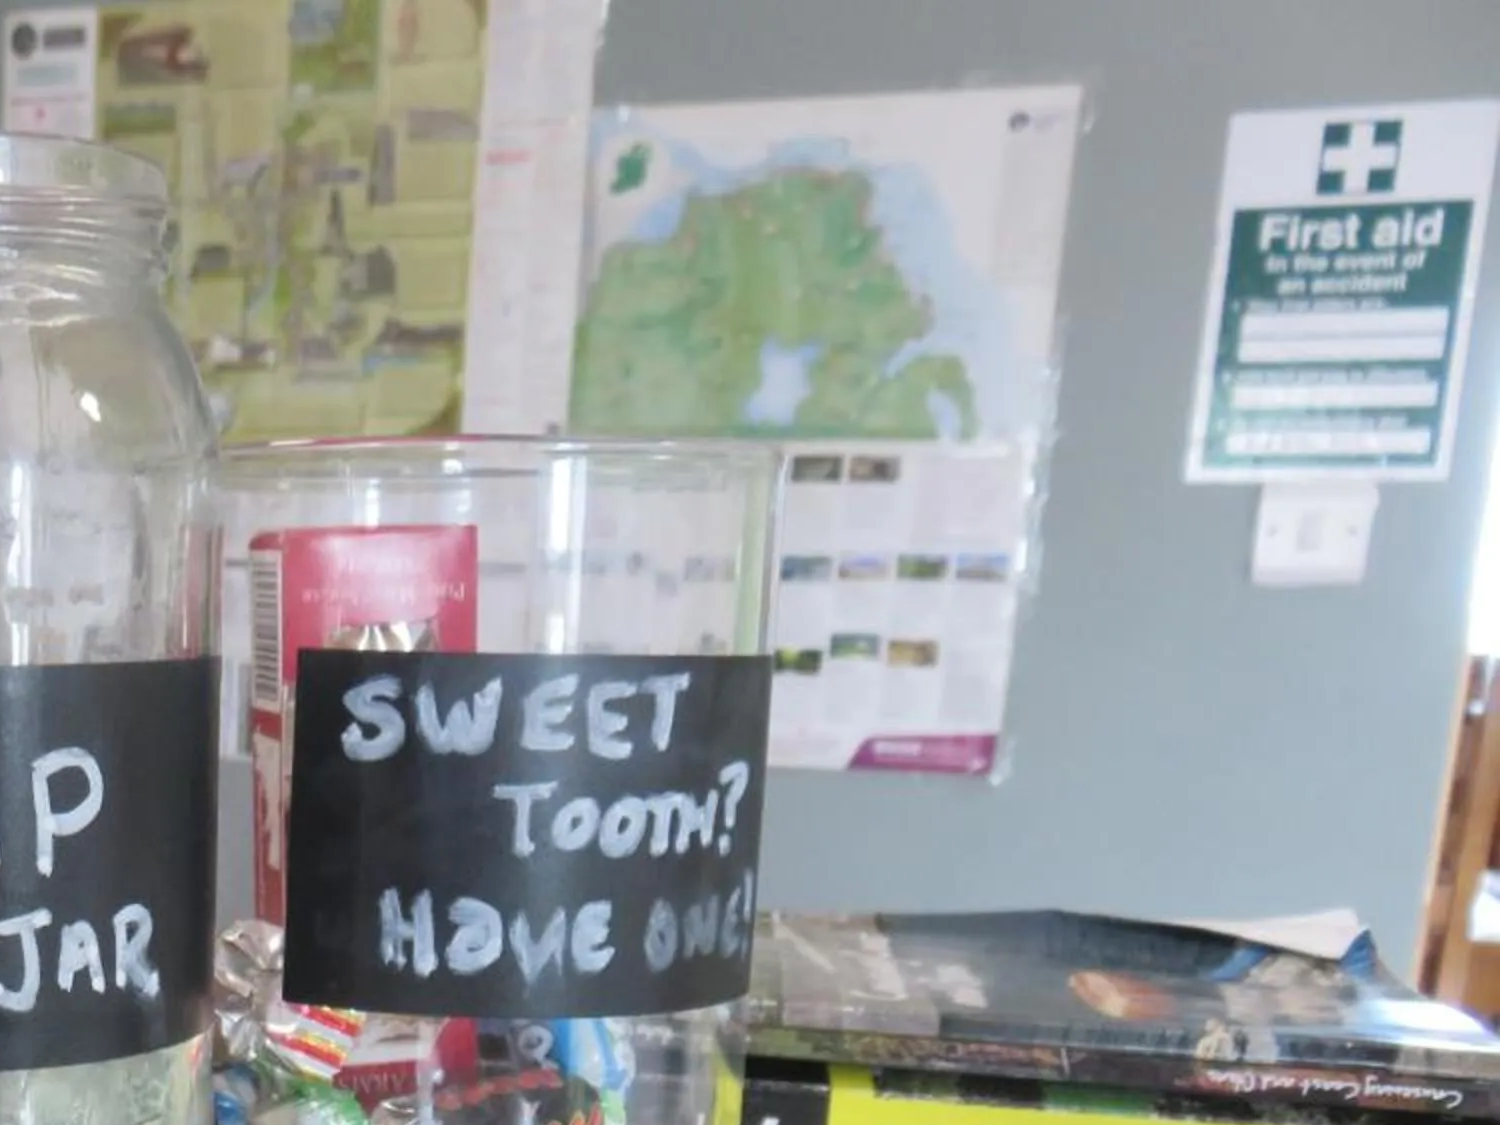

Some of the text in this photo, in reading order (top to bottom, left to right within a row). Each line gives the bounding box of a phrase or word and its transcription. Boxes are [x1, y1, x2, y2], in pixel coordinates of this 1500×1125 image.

[1258, 207, 1446, 251] First aid
[341, 671, 690, 762] SWEET
